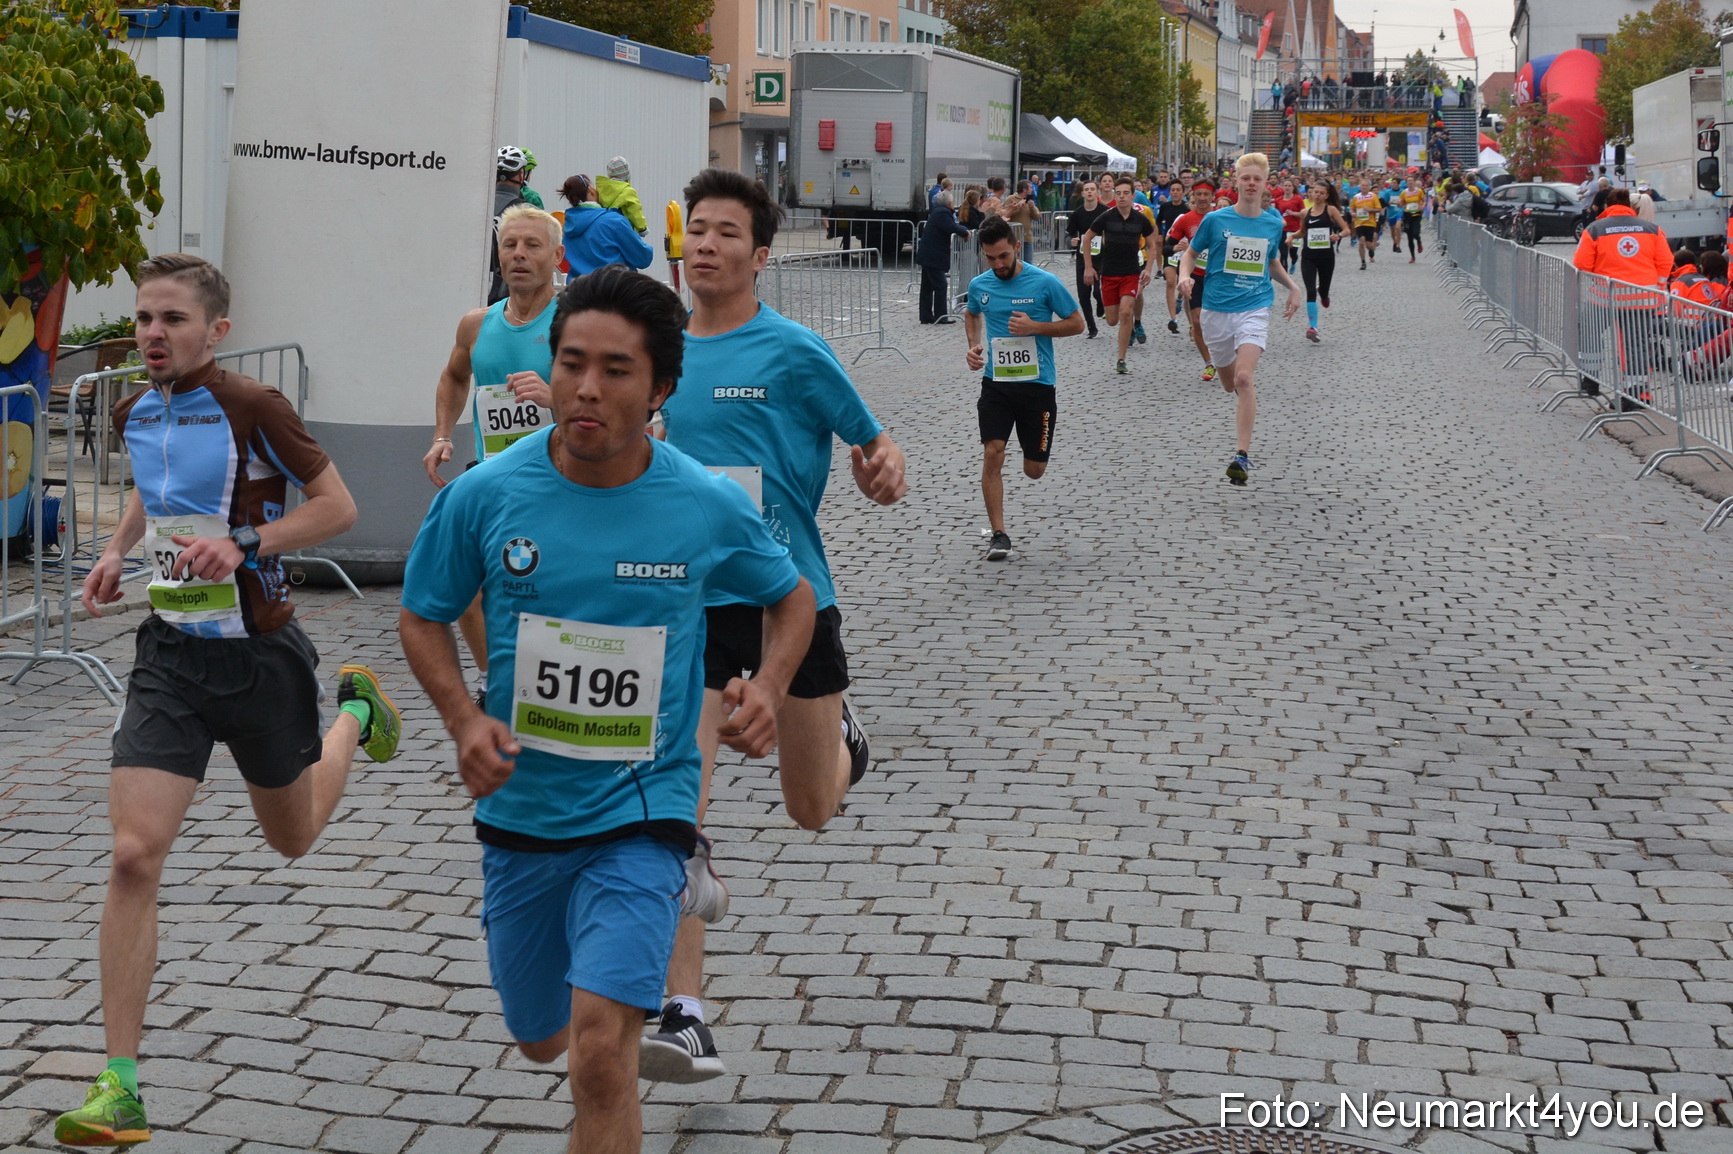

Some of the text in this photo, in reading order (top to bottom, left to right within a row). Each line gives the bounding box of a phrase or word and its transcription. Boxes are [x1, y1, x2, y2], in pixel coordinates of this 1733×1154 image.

[759, 77, 780, 98] D
[988, 103, 1012, 140] BOCK
[1350, 115, 1379, 125] ZIEL
[233, 139, 446, 170] www.bmw-laufsport.de
[1605, 225, 1644, 234] BEREITSCHAFTEN
[1232, 247, 1261, 262] 5239
[998, 350, 1031, 365] 5186
[713, 387, 768, 399] BOCK
[487, 404, 540, 431] 5048
[615, 562, 689, 579] BOCK
[502, 580, 538, 593] PARTL
[574, 634, 625, 651] BOCK
[536, 660, 640, 708] 5196
[527, 711, 641, 737] Gholam Mostafa
